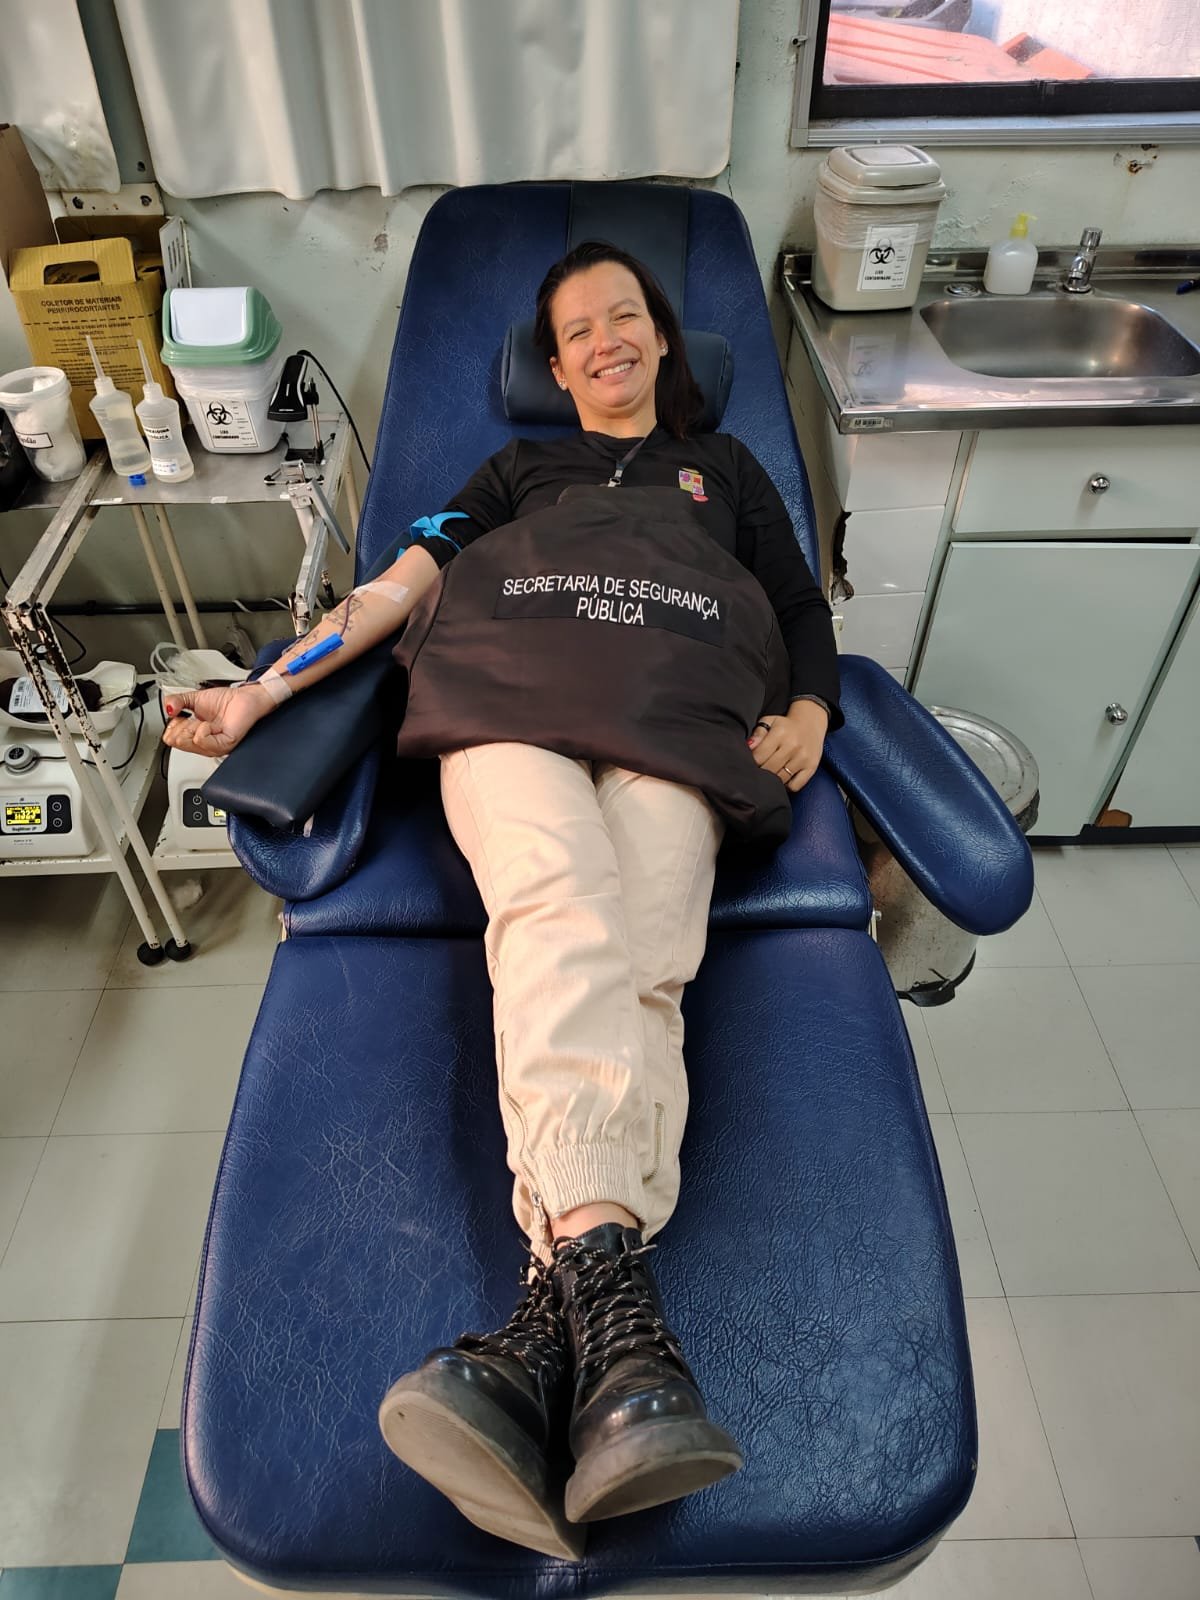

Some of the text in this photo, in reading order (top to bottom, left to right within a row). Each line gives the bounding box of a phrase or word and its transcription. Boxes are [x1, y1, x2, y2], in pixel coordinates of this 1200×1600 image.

[41, 299, 73, 307] COLETOR
[85, 296, 122, 304] MATERIAIS
[503, 575, 720, 620] SECRETARIA DE SEGURANÇA
[576, 593, 645, 626] PÚBLICA
